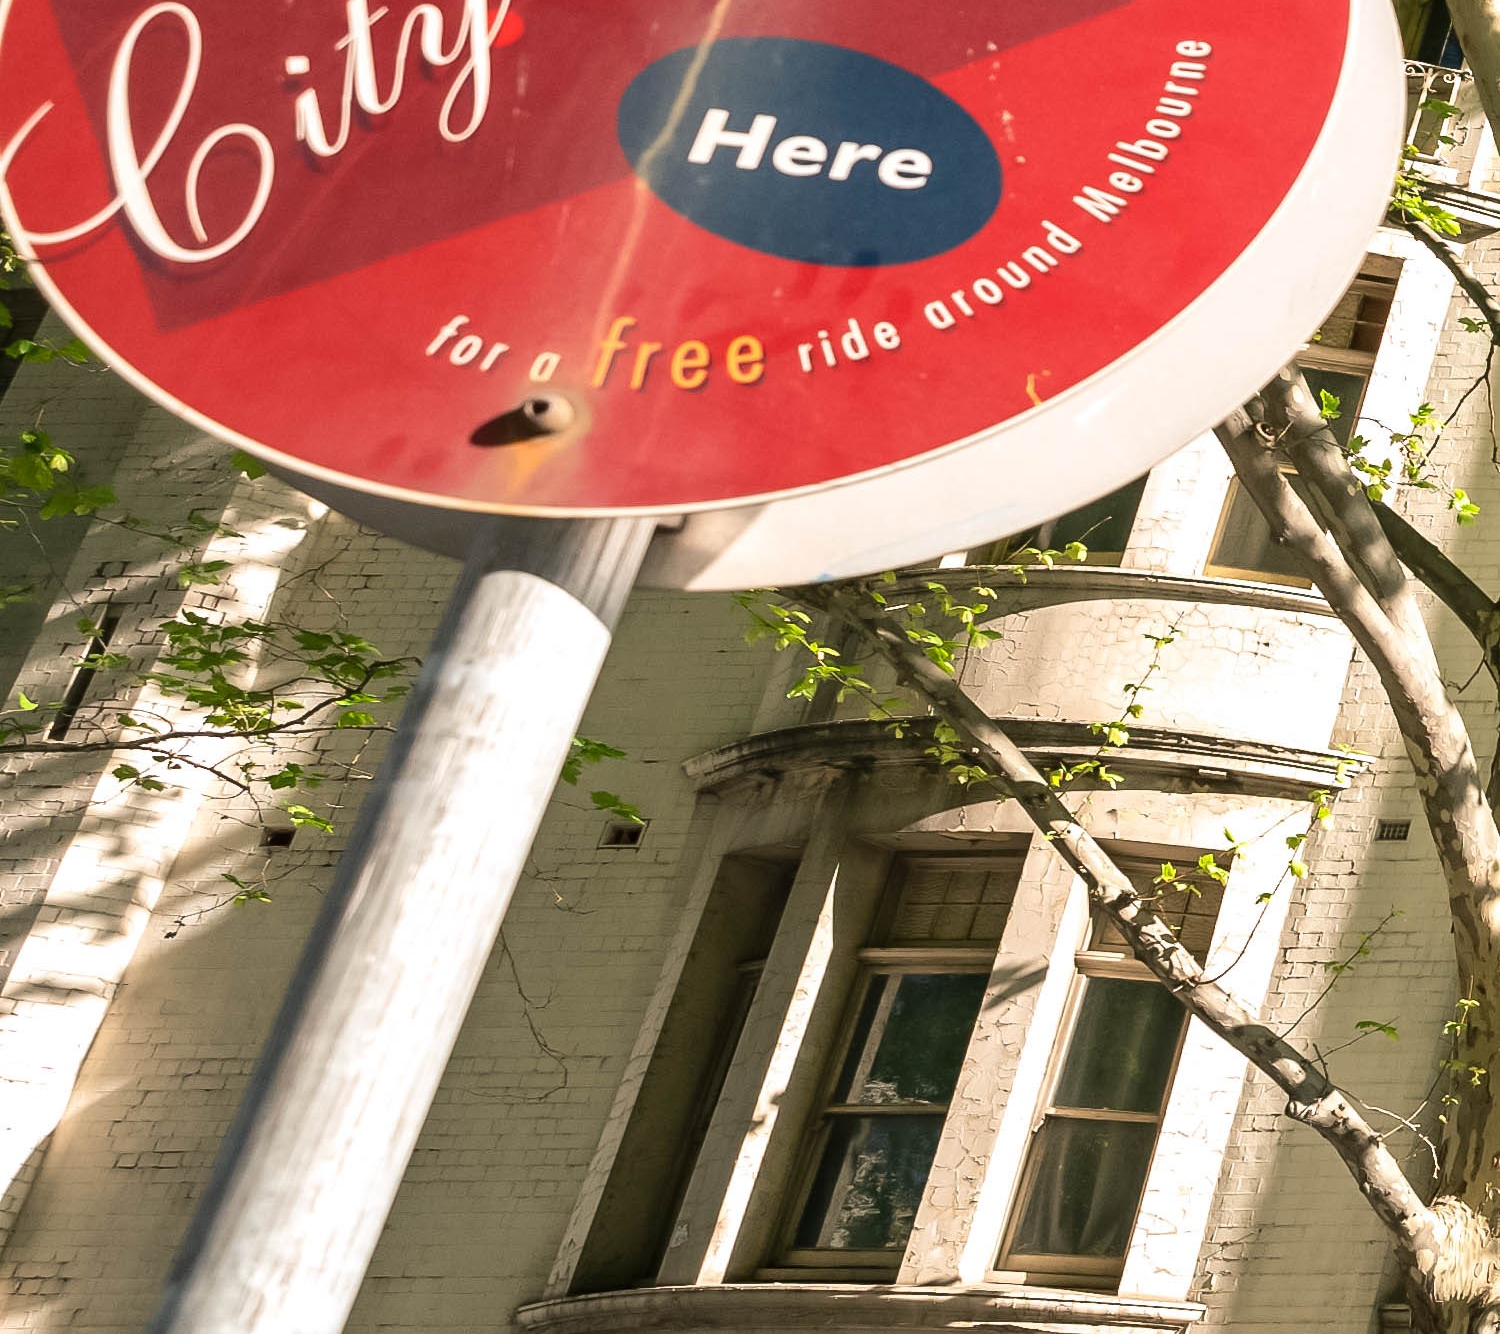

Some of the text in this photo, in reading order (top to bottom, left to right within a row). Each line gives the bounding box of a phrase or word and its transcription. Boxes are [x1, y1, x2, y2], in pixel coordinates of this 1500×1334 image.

[425, 36, 1213, 391] for a free ride around Melbourne
[685, 107, 935, 194] Here
